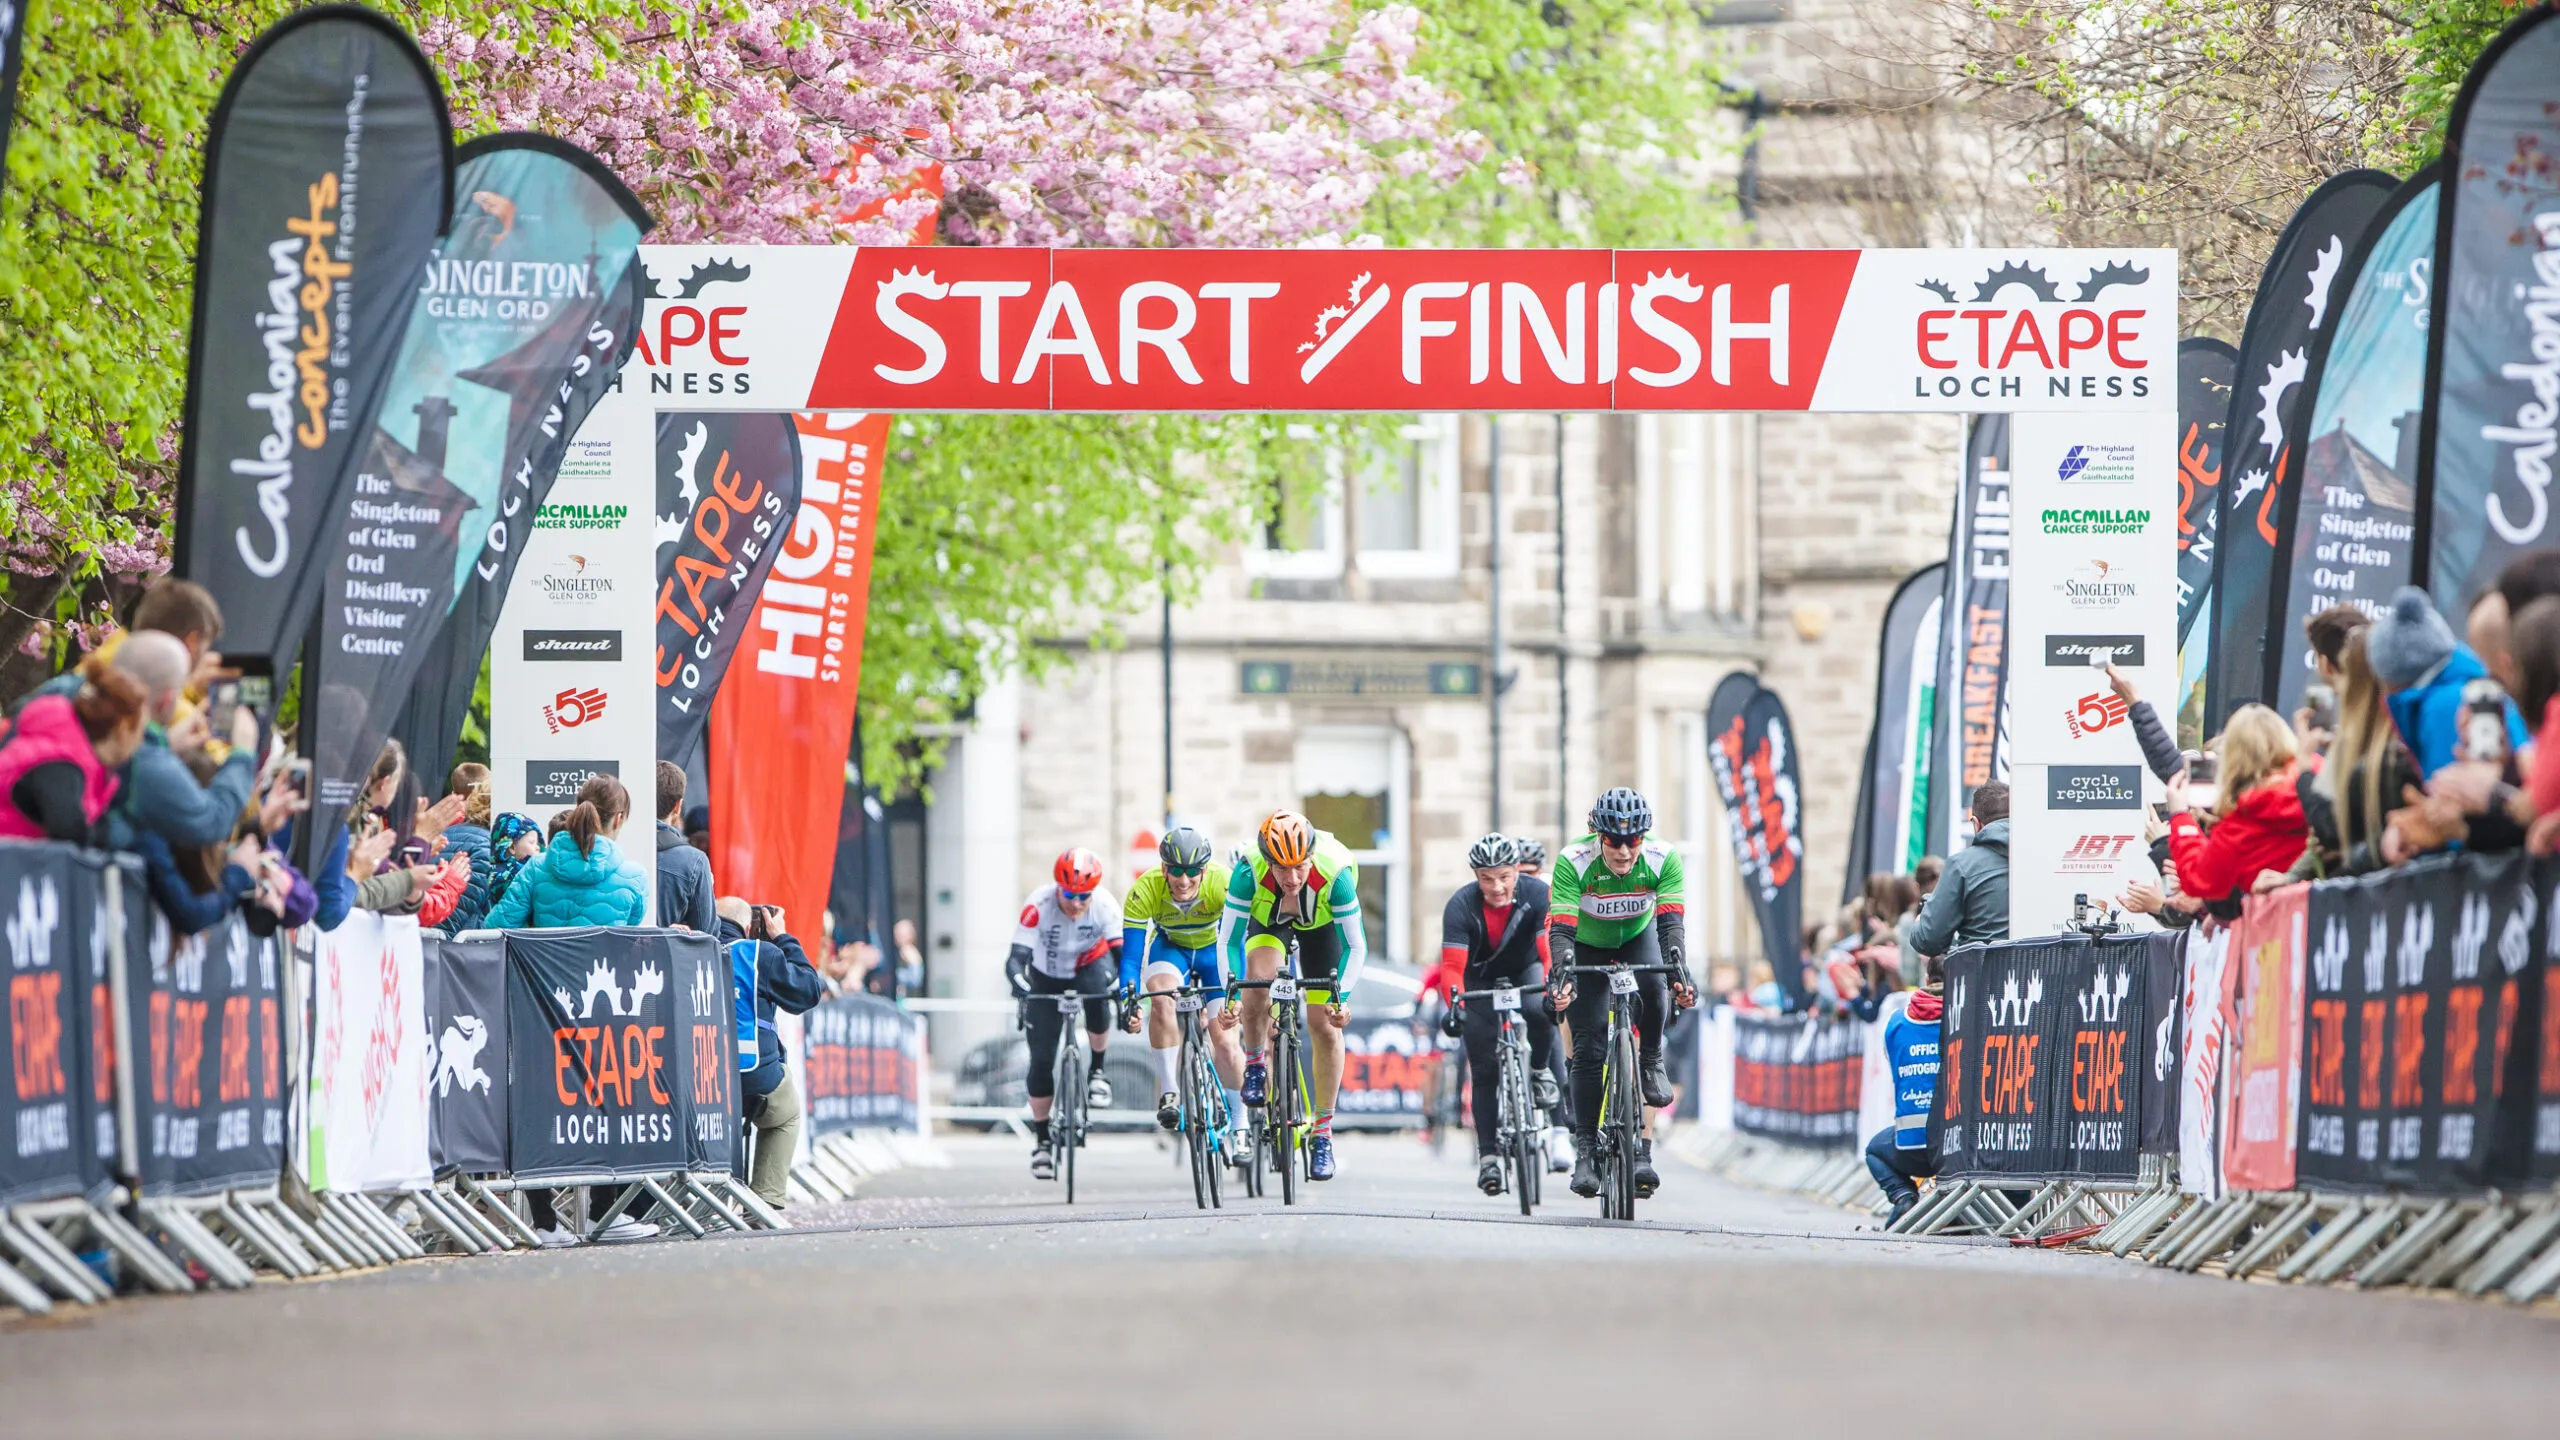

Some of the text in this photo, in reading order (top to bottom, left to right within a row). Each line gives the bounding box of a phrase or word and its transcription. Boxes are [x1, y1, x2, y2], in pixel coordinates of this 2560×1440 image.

[329, 73, 370, 431] The Event Frontrunners
[286, 171, 353, 449] concepts
[427, 297, 550, 320] GLEN ORD
[873, 265, 1790, 388] START FINISH
[1917, 309, 2149, 369] ETAPE
[651, 373, 750, 394] NESS
[1915, 376, 2149, 397] LOCH NESS
[231, 237, 303, 577] Caledonian
[578, 441, 611, 449] Highland
[2101, 445, 2135, 453] Highland
[356, 474, 391, 494] The
[2323, 485, 2365, 509] The
[350, 500, 441, 525] Singleton
[477, 456, 534, 582] LOCH
[536, 504, 628, 518] ACMILLAN
[2041, 509, 2150, 524] MACMILLAN
[532, 520, 621, 529] ANCER SUPPORT
[2043, 524, 2144, 534] CANCER SUPPORT
[348, 527, 416, 549] of Glen
[347, 553, 385, 574] Ord
[821, 443, 868, 683] SPORTS NUTRITION
[2316, 541, 2391, 567] of Glen
[2313, 567, 2355, 591] Ord
[345, 580, 430, 607] Distillery
[549, 592, 597, 600] GLEN ORD
[671, 491, 782, 714] LOCH NESS
[2071, 597, 2120, 605] GLEN ORD
[344, 606, 406, 628] Visitor
[341, 633, 404, 656] Centre
[533, 640, 612, 651] shand
[542, 705, 560, 734] HIGH
[2064, 709, 2082, 740] HIGH
[549, 769, 598, 784] cycle
[2071, 774, 2120, 789] cycle
[534, 783, 581, 797] repub
[2056, 788, 2133, 803] republic
[2062, 835, 2136, 859] JBT
[1597, 900, 1647, 914] DEESIDE
[1275, 987, 1292, 995] 443
[1614, 978, 1632, 988] 545
[1181, 1001, 1197, 1009] 671
[1909, 1043, 1938, 1057] OFFICI
[553, 1024, 670, 1107] ETAPE
[692, 1024, 722, 1104] ETAPE
[1981, 1034, 2040, 1114] ETAPE
[2072, 1029, 2127, 1113] ETAPE
[555, 1113, 672, 1145] LOCH NESS
[1977, 1122, 2005, 1150] LOCH
[2007, 1122, 2032, 1151] NESS
[2099, 1121, 2123, 1151] NESS
